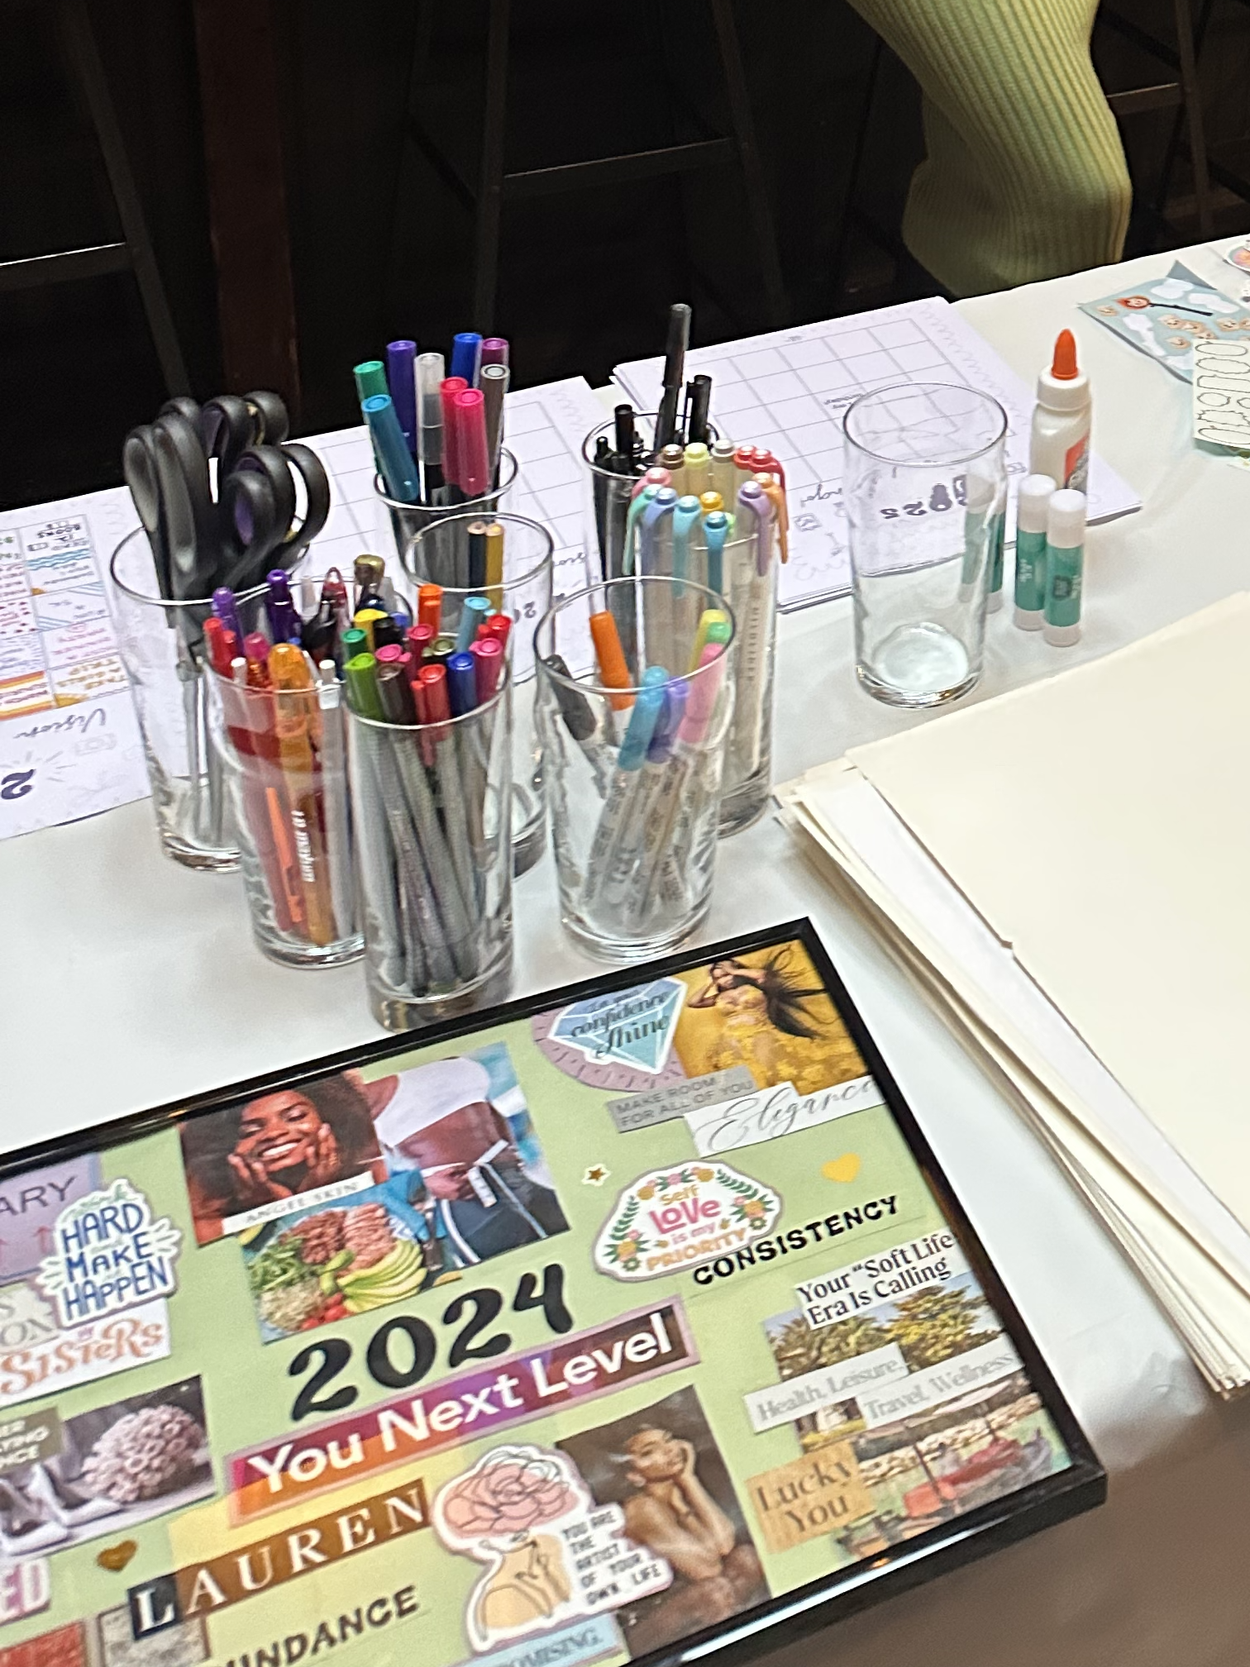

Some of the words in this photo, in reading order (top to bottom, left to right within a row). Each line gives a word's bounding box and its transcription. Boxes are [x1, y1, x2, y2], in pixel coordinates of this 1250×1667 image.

[571, 991, 671, 1037] confidence
[616, 1092, 664, 1114] MAKE
[668, 1077, 718, 1098] ROOM
[621, 1109, 655, 1127] FOR
[659, 1099, 690, 1116] ALL
[692, 1091, 715, 1107] OF
[720, 1081, 755, 1098] YOU
[62, 1203, 145, 1254] HARD
[647, 1228, 746, 1271] PRIORITY
[693, 1195, 899, 1285] CONSISTENCY
[65, 1232, 152, 1283] MAKE
[797, 1271, 852, 1304] Your
[911, 1232, 954, 1261] Life
[63, 1257, 169, 1320] HAPPEN
[806, 1299, 849, 1325] Era
[850, 1290, 872, 1310] Is
[874, 1256, 952, 1298] Calling
[287, 1263, 574, 1420] 2024
[934, 1351, 1014, 1391] Wellness
[248, 1433, 364, 1494] You
[377, 1374, 523, 1453] Next
[530, 1312, 672, 1398] Level
[757, 1460, 851, 1511] Lucky
[785, 1496, 850, 1532] You
[136, 1487, 424, 1632] LAUREN
[576, 1543, 621, 1571] ARTIST
[580, 1572, 598, 1588] OF
[610, 1553, 644, 1575] YOUR
[586, 1583, 620, 1605] OWN
[631, 1564, 662, 1585] LIFE
